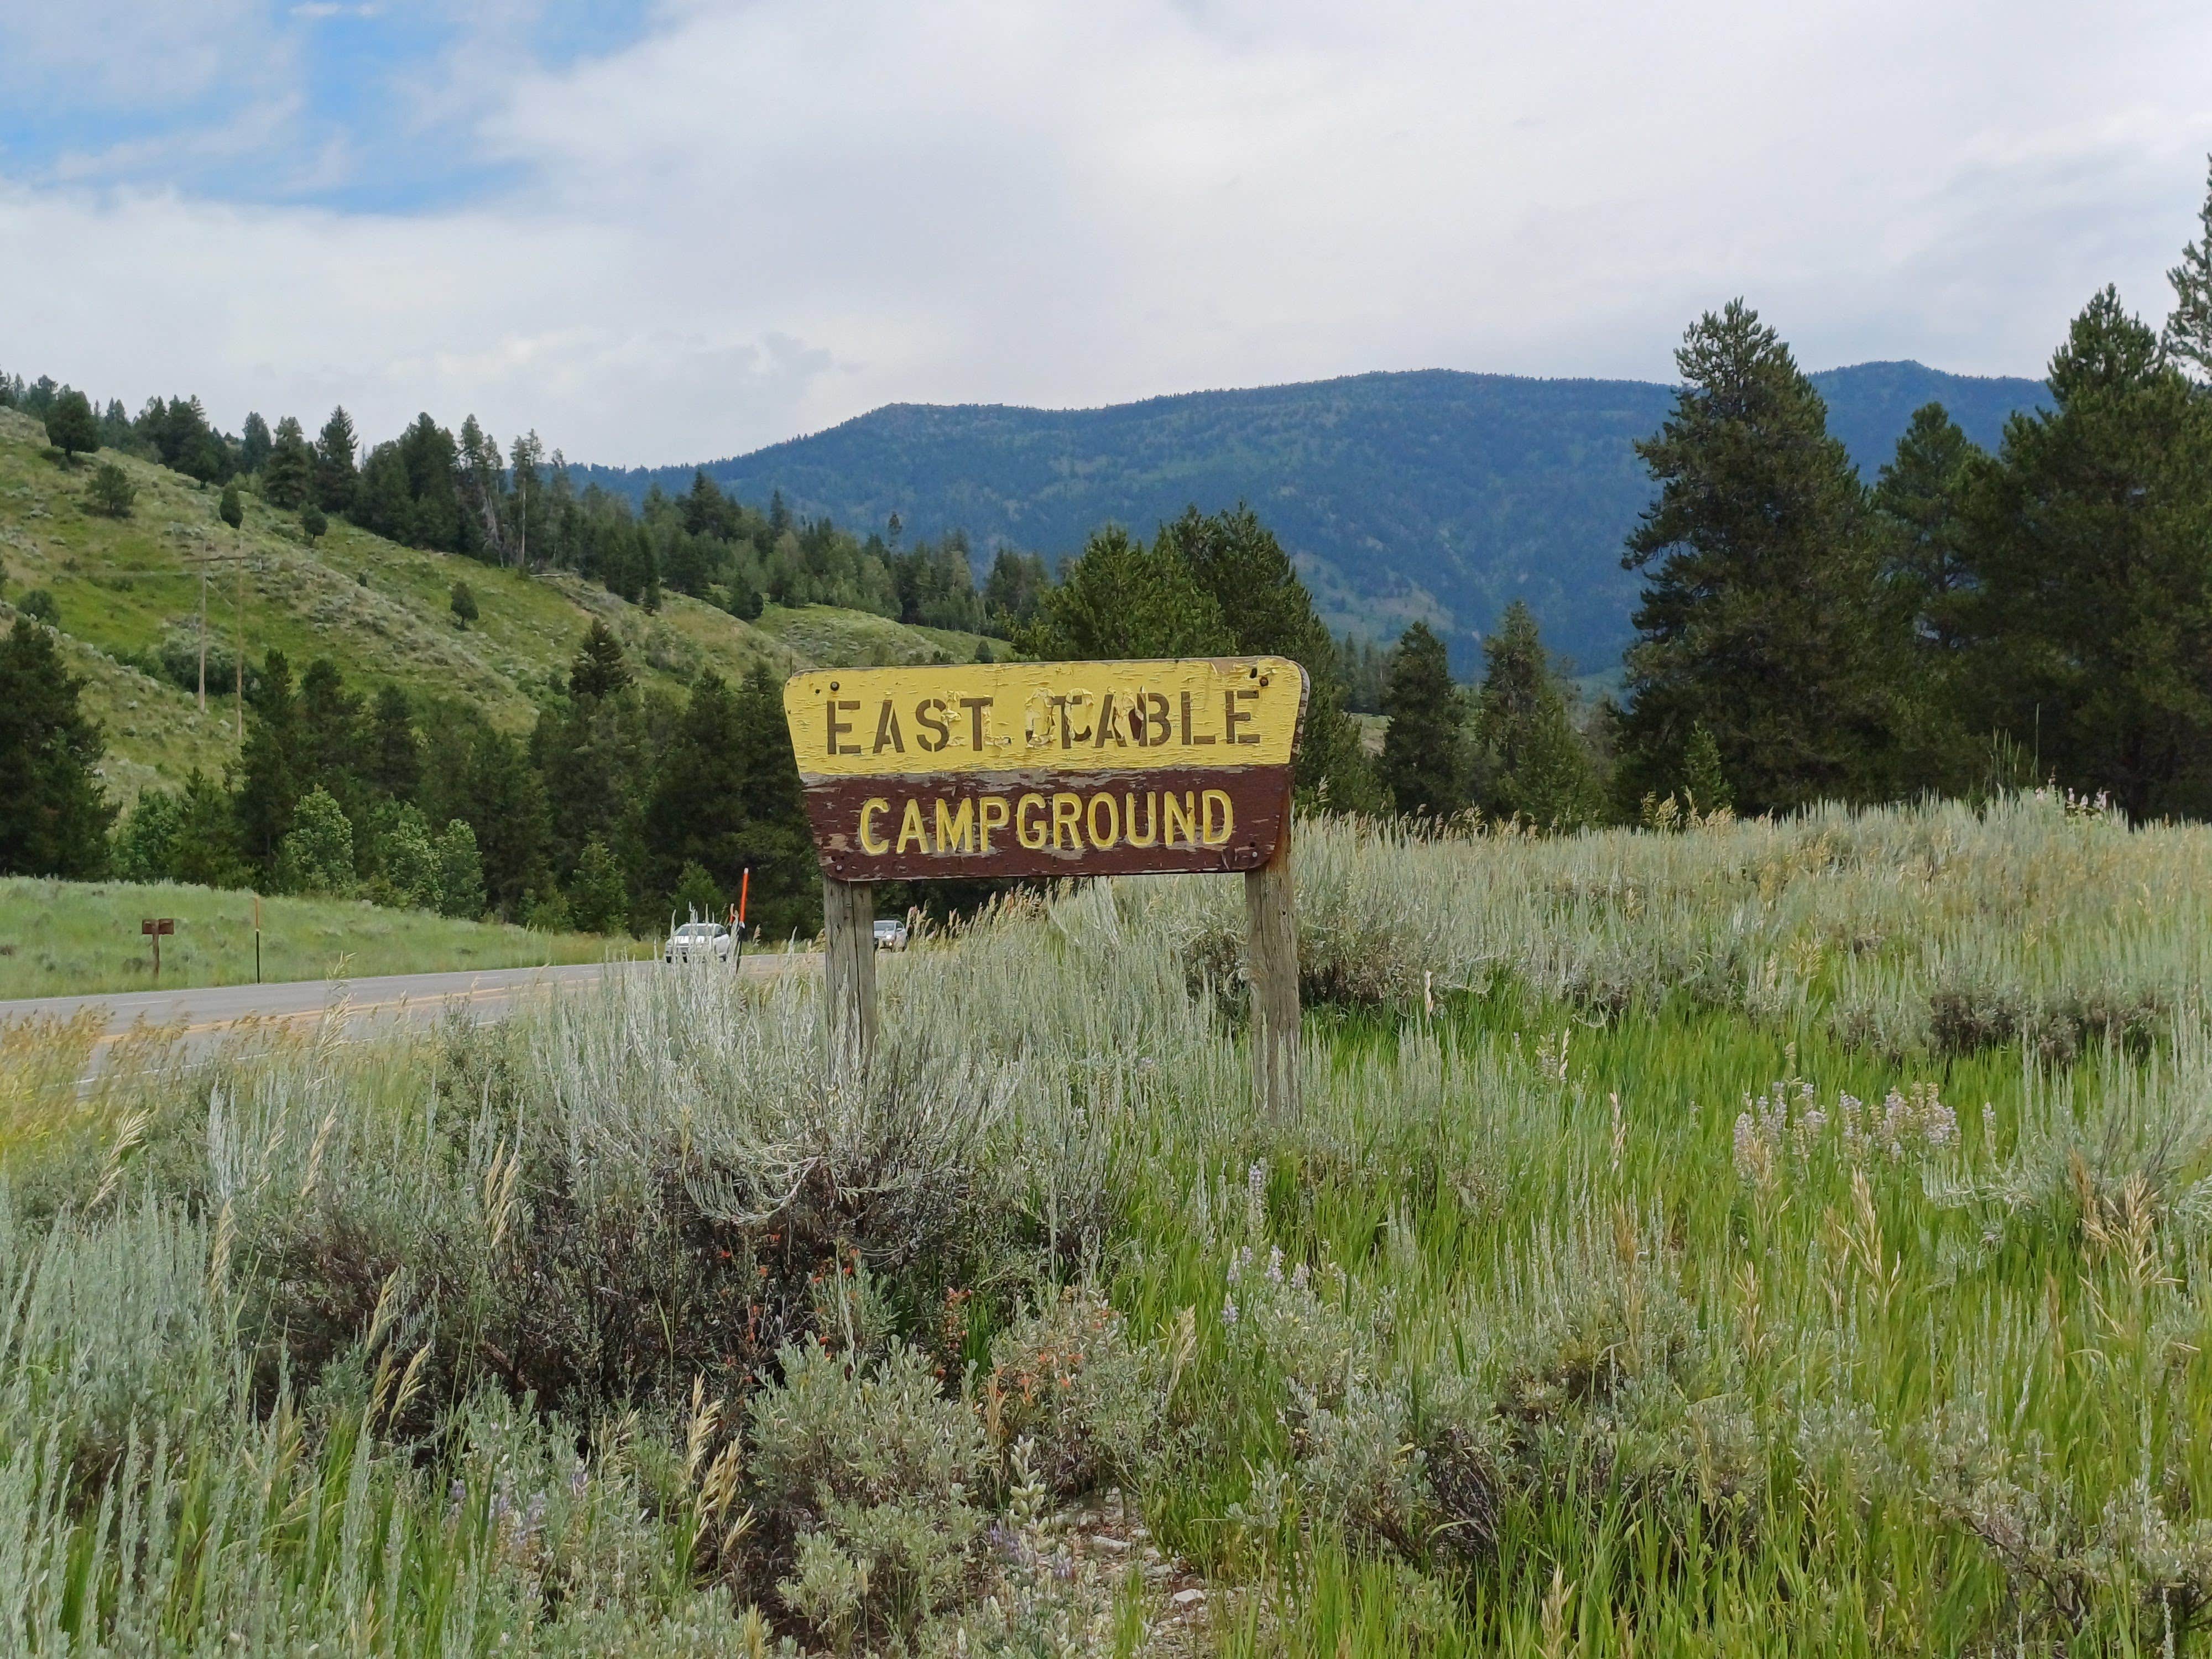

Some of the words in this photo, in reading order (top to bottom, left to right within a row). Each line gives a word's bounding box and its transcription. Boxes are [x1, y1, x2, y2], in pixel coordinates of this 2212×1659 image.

[827, 697, 994, 755] EAST
[1047, 690, 1261, 749] TABLE
[859, 789, 1234, 854] CAMPGROUND
